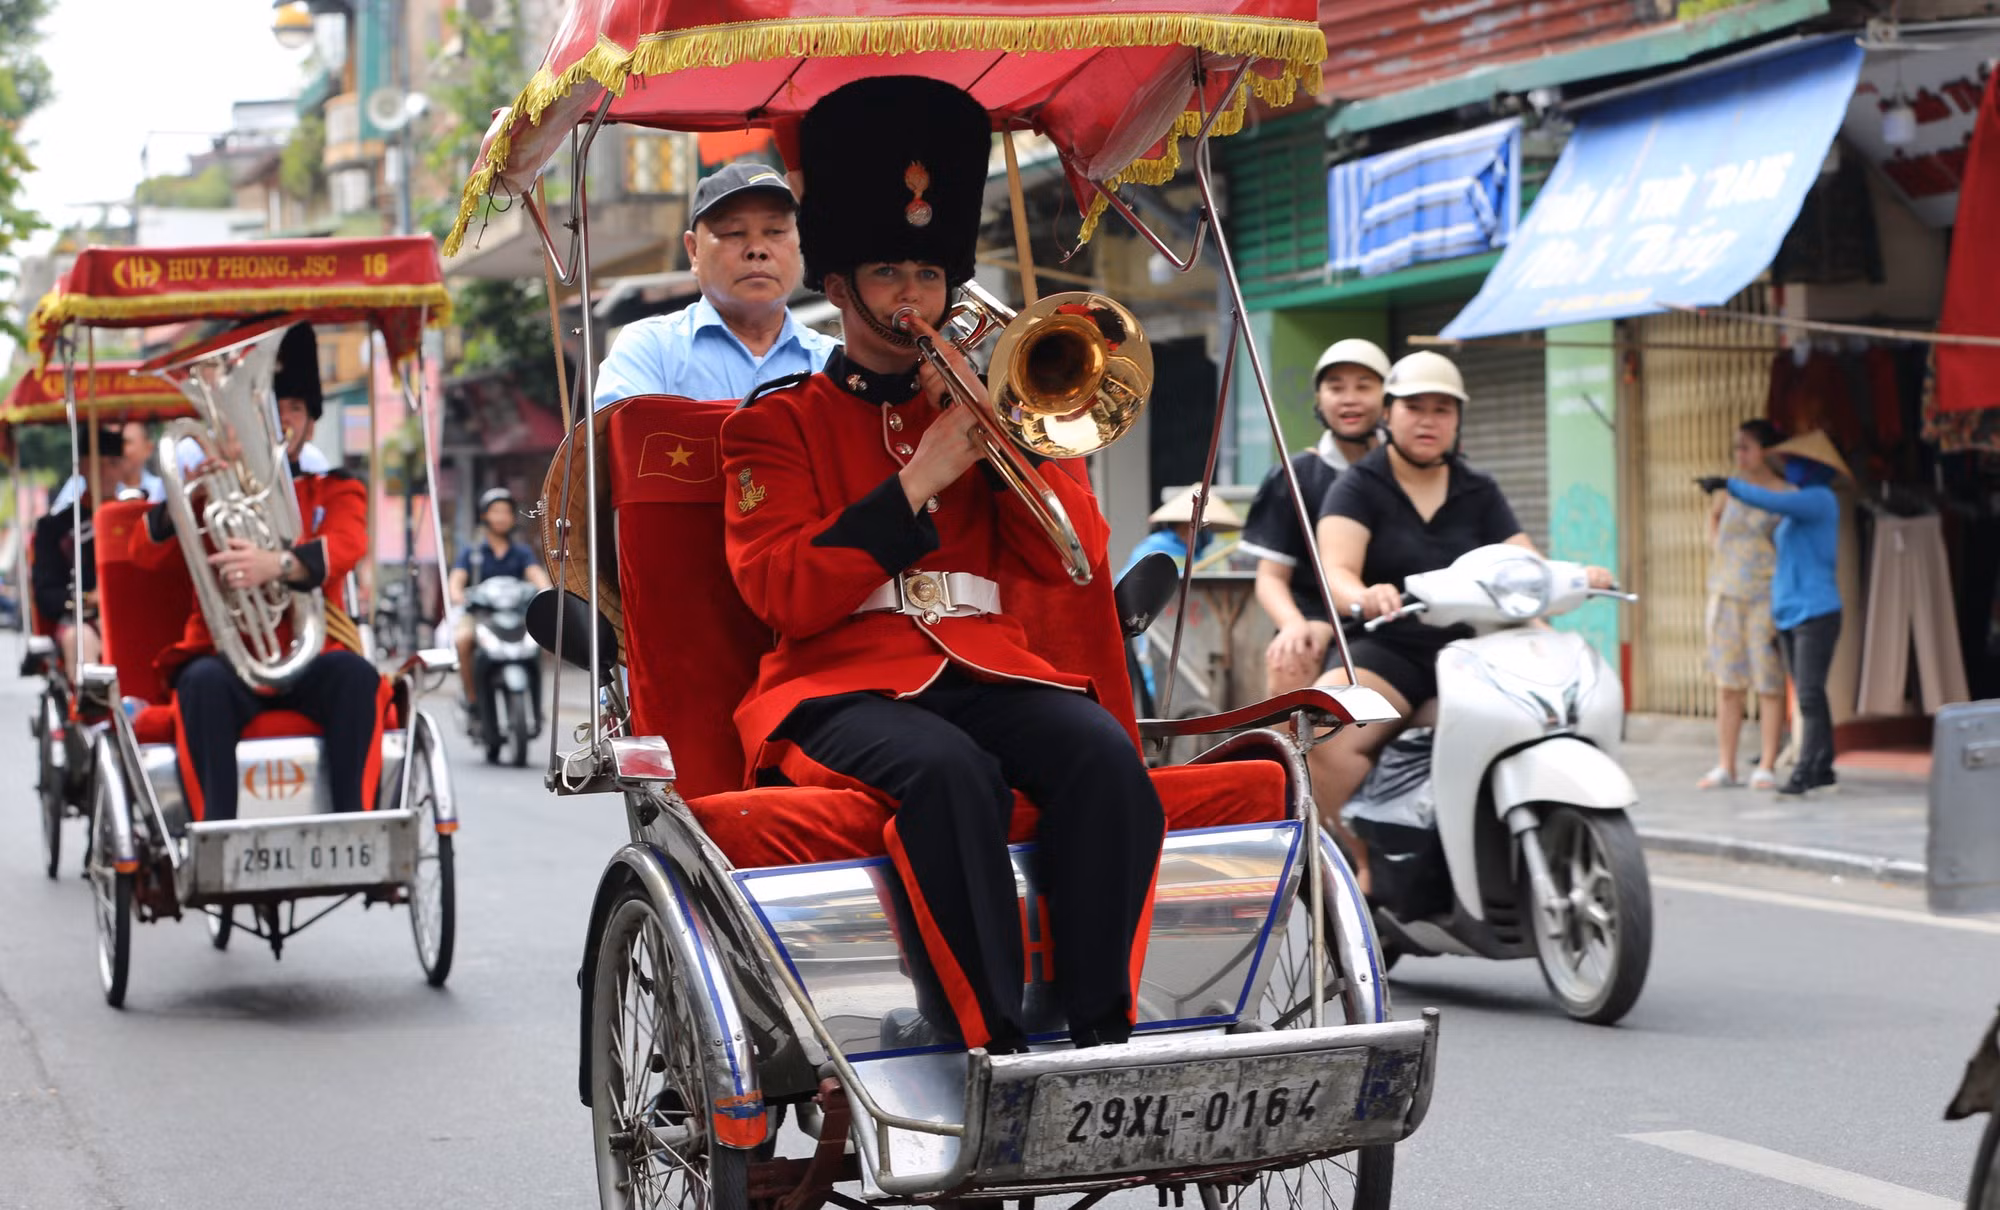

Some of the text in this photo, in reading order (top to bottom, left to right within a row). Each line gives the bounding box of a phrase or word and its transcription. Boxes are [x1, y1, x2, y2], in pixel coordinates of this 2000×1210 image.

[168, 257, 210, 281] HUY
[310, 845, 371, 869] 0116
[1066, 1079, 1321, 1143] 29XL-0164
